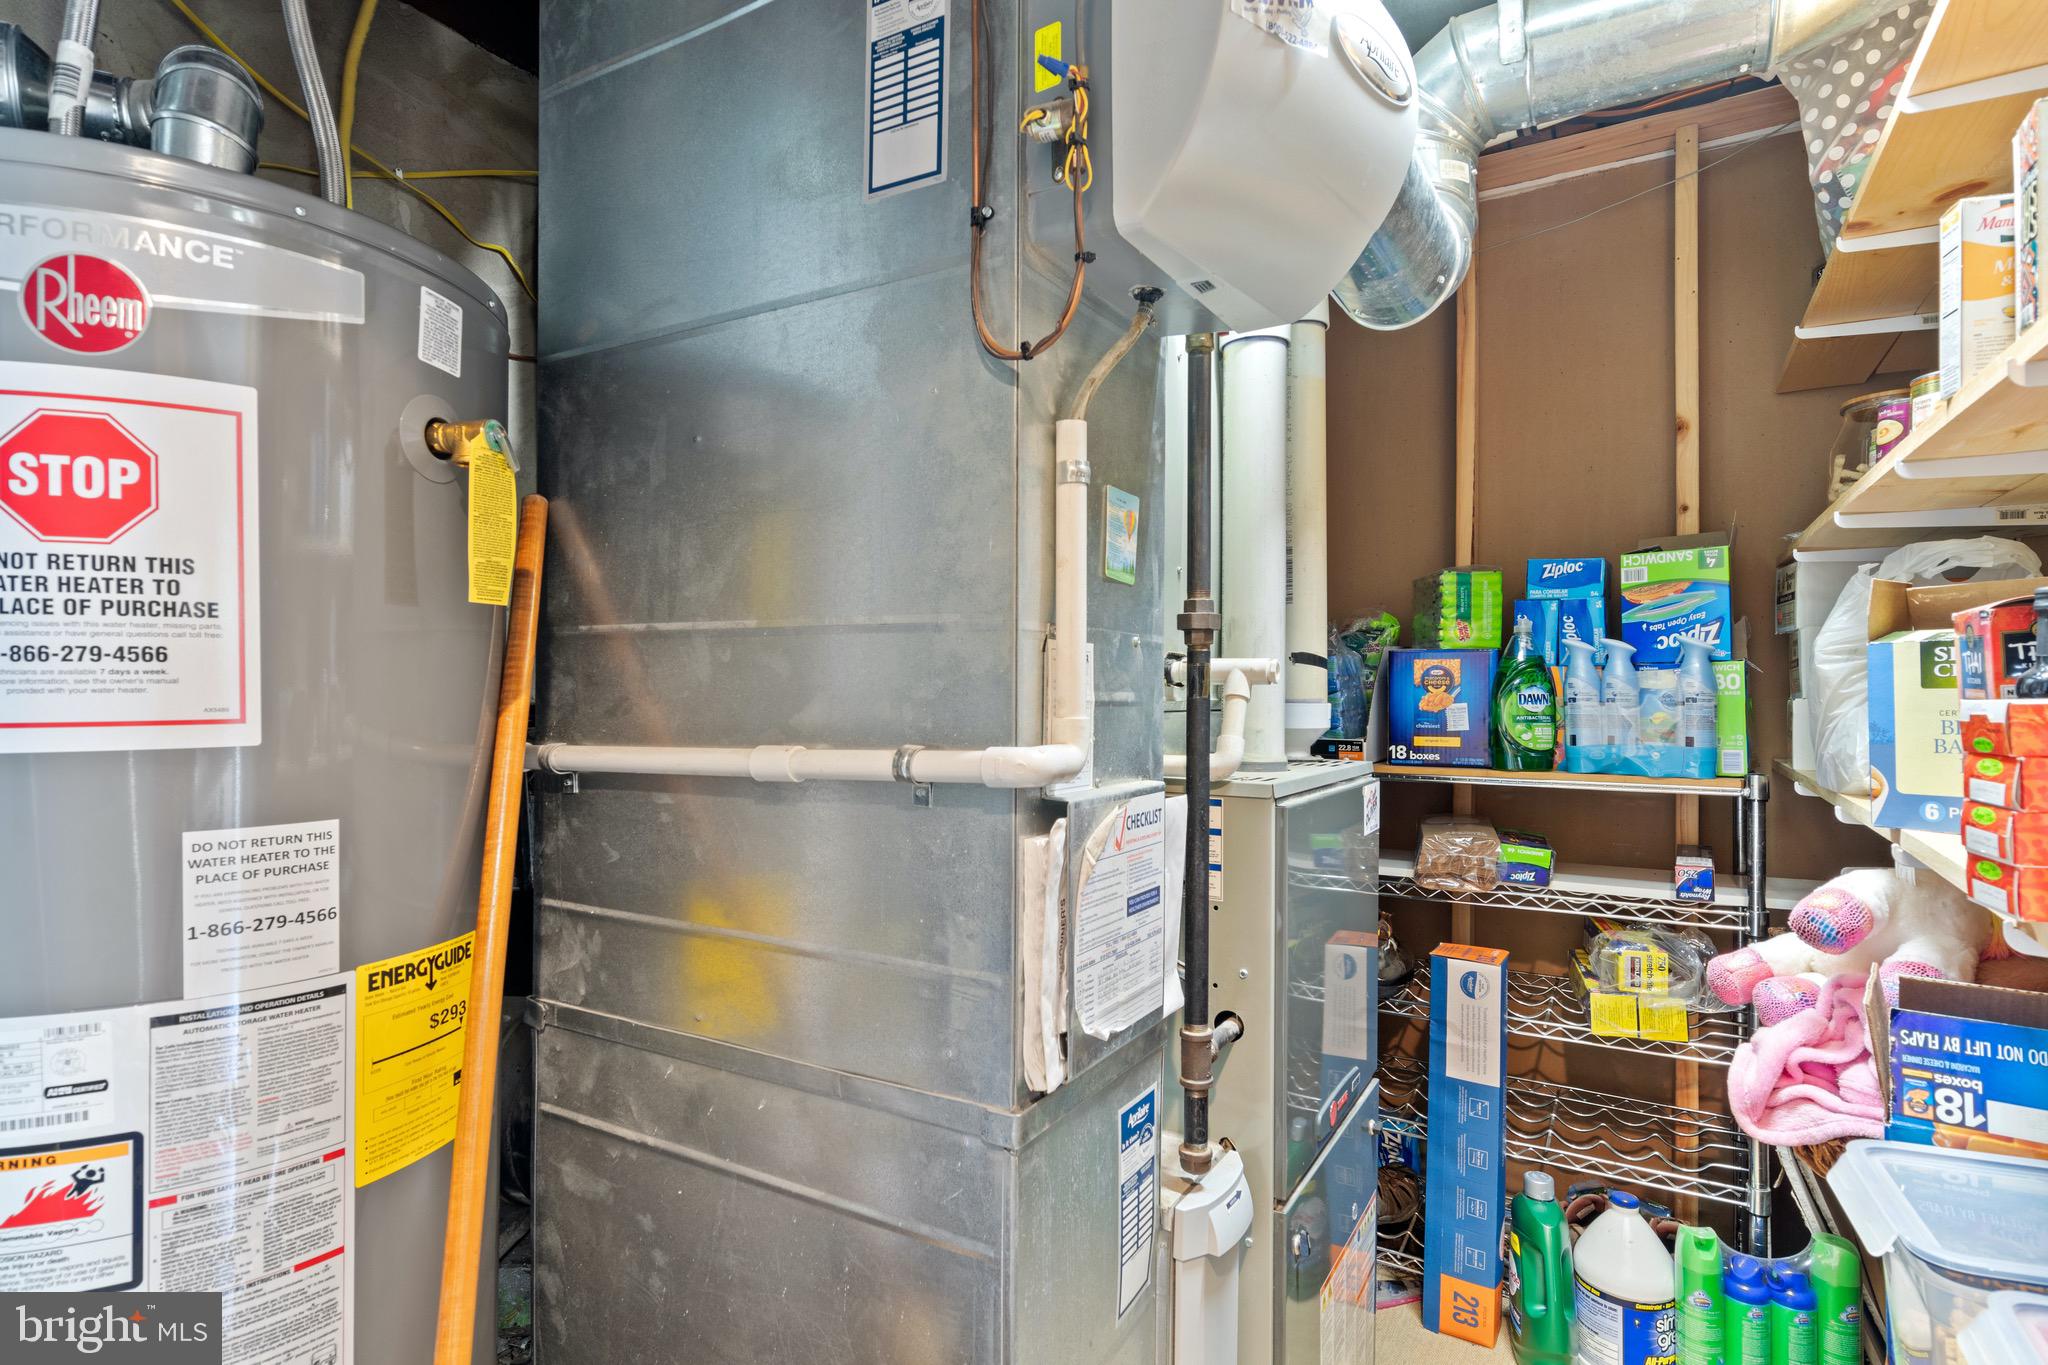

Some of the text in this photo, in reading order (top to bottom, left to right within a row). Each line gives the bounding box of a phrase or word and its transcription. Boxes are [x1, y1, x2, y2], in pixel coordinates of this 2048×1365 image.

[36, 254, 144, 339] Rheem
[8, 452, 141, 500] STOP
[0, 552, 196, 576] NOT RETURN THIS
[1623, 549, 1694, 567] SANDWICH
[1706, 557, 1716, 568] 4
[1541, 560, 1584, 579] Ziploc
[57, 576, 144, 595] HEATER
[152, 579, 181, 597] TO
[63, 598, 92, 617] OF
[100, 599, 220, 619] PURCHASE
[1562, 615, 1582, 641] ploc
[1649, 611, 1706, 632] Easy Open Tabs
[1714, 664, 1740, 672] WICH
[1518, 693, 1550, 705] DAWN
[1388, 745, 1440, 760] 18 boxes
[1126, 808, 1162, 831] CHECKLIST
[1924, 803, 1940, 819] 6
[191, 830, 333, 853] DO NOT RETURN THIS
[188, 845, 336, 869] WATER HEATER TO THE
[195, 861, 330, 885] PLACE OF PURCHASE
[1510, 871, 1536, 882] Ziploc
[1677, 869, 1699, 879] 250
[1693, 887, 1712, 895] Wrap
[187, 906, 338, 940] 1-866-279-4566
[254, 997, 296, 1011] OPERATION
[296, 990, 324, 1003] DETAILS
[269, 1010, 294, 1020] WATER
[295, 1004, 321, 1015] HEATER
[429, 1000, 467, 1030] $293
[1900, 1029, 2048, 1067] DO NOT LIFT BY FLAPS
[1934, 1073, 1983, 1095] boxes
[1934, 1087, 1986, 1128] 18
[1452, 1290, 1480, 1329] 213
